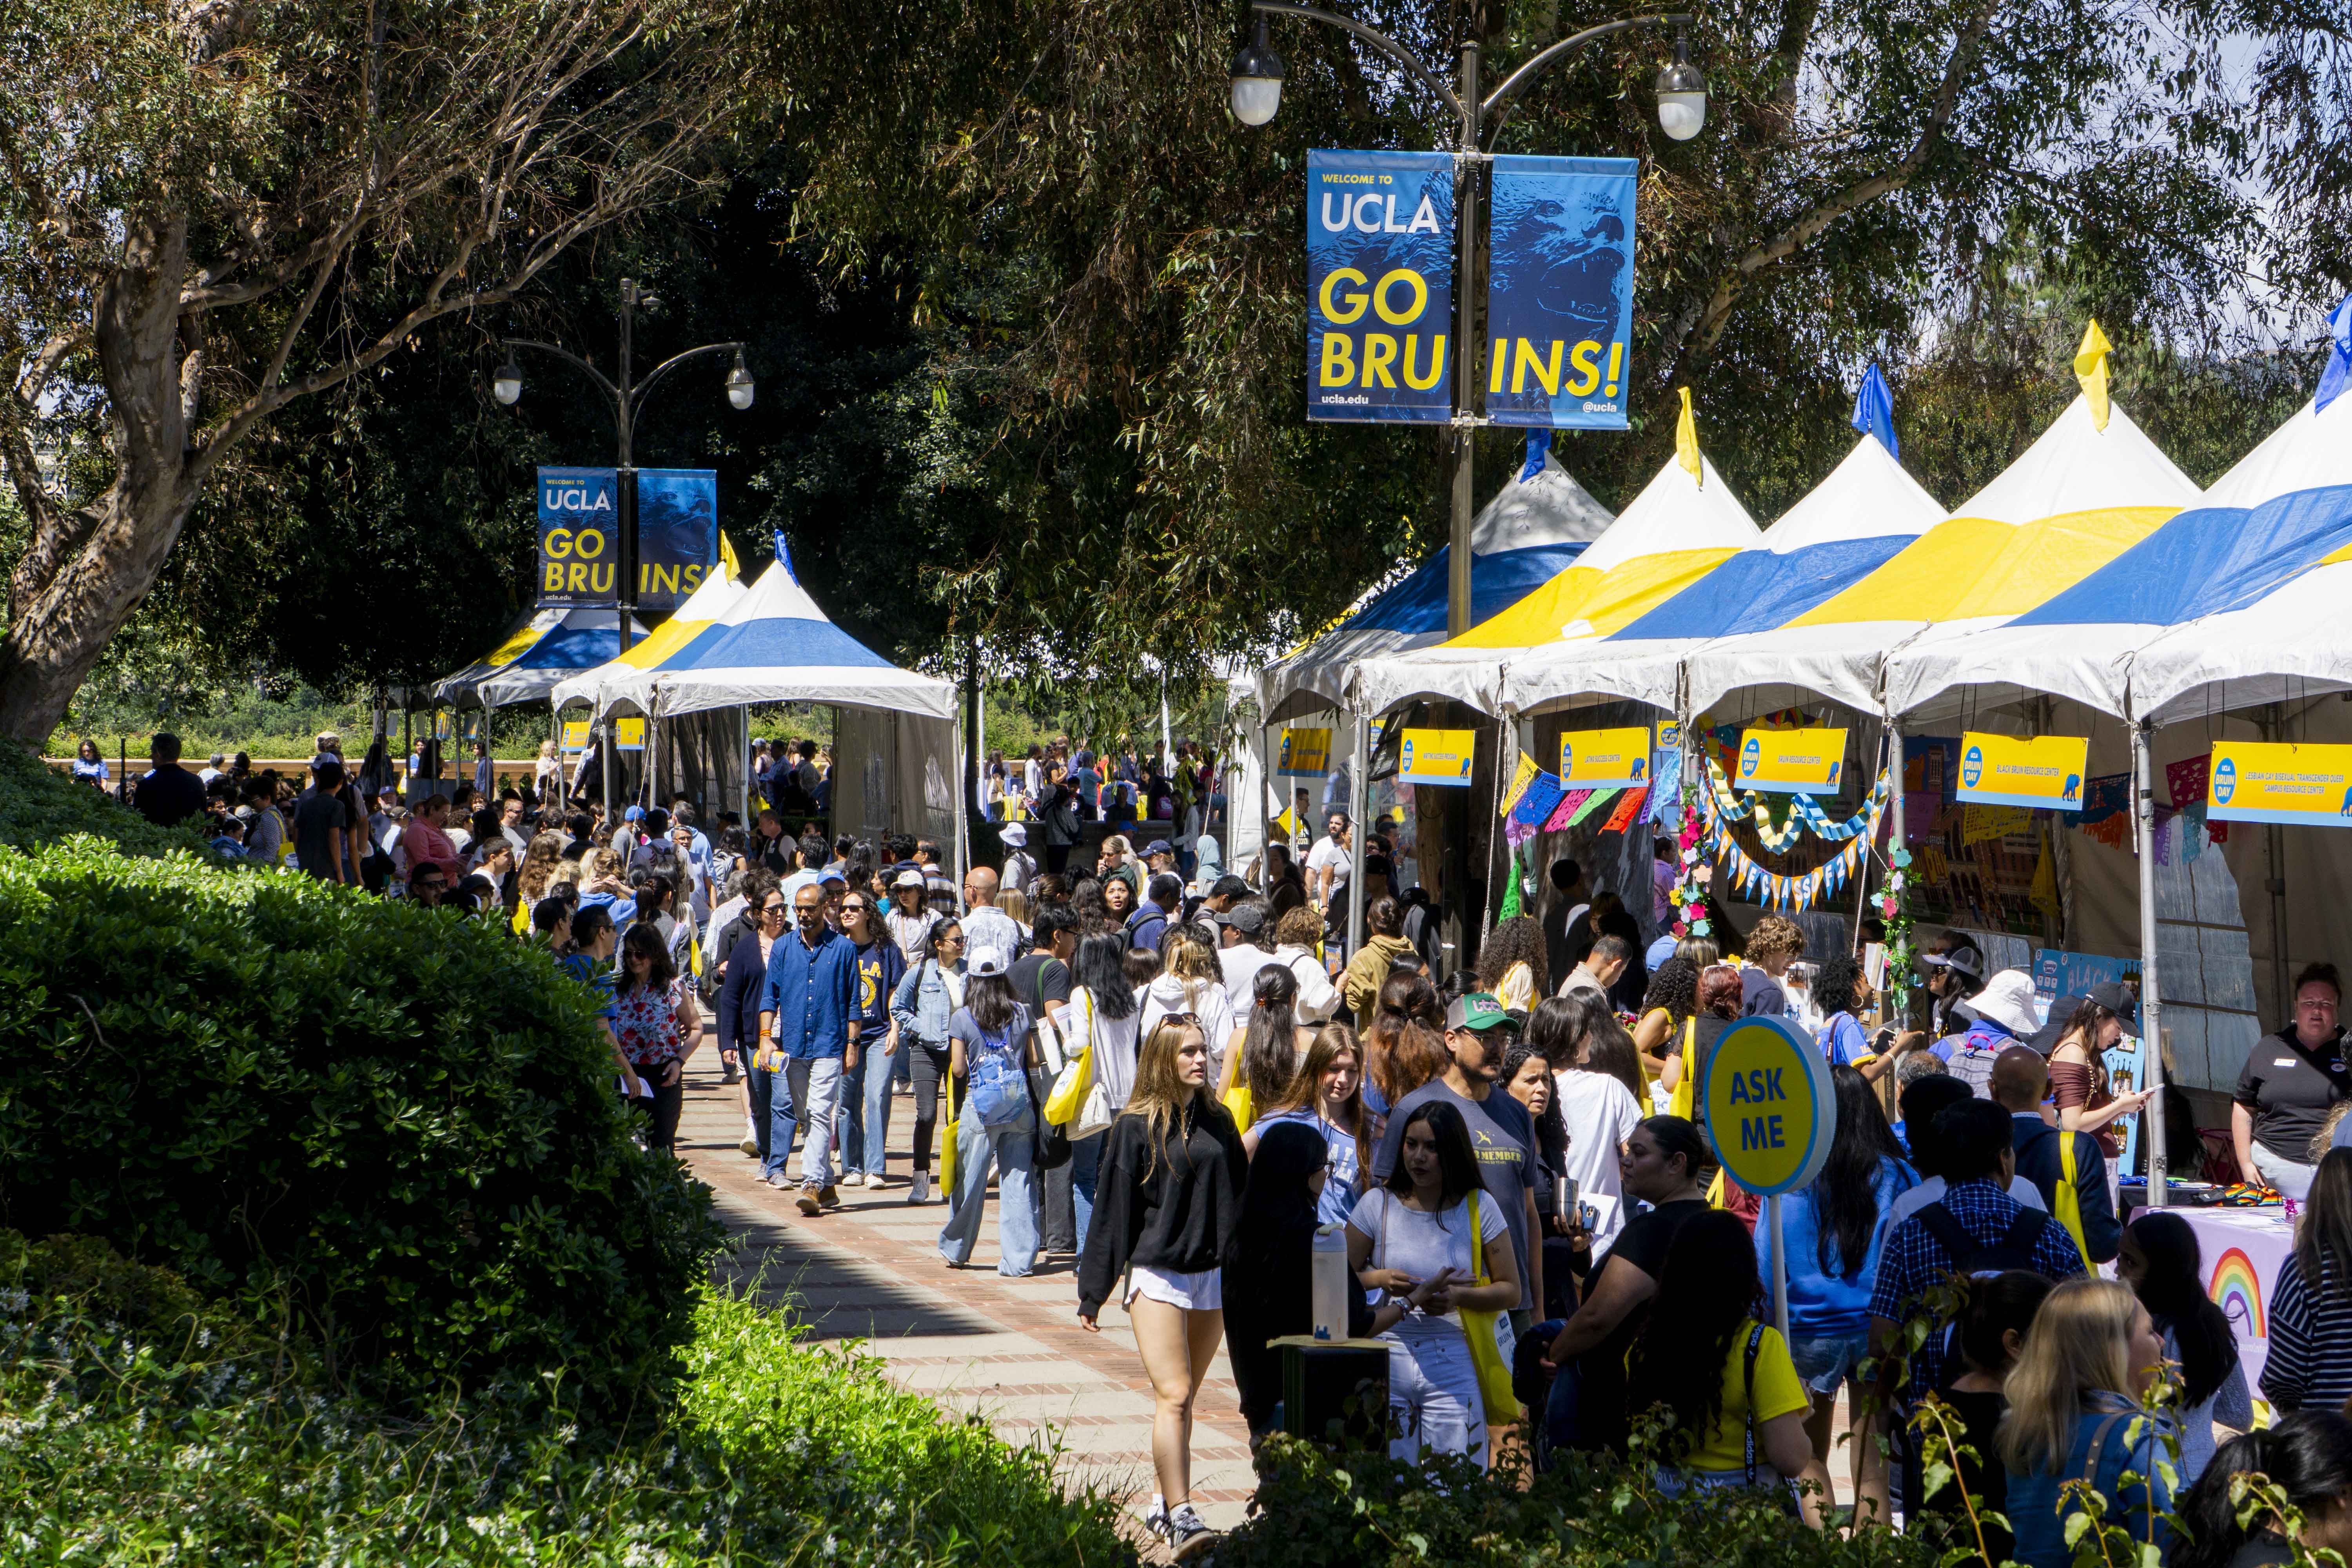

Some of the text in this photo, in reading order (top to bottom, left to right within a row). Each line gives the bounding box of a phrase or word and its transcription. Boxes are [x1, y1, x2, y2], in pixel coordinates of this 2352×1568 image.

[1322, 174, 1392, 184] WELCOME TO
[1321, 192, 1440, 233] UCLA
[1319, 267, 1428, 325] GO
[1319, 332, 1623, 398] BRU INS!
[1321, 395, 1369, 405] ucla.edu
[1583, 402, 1617, 413] @ucla
[546, 489, 611, 510] UCLA
[545, 528, 604, 559] GO
[544, 563, 615, 593] BRU
[1743, 752, 1758, 761] BRUIN
[1744, 762, 1755, 770] DAY
[1965, 760, 1981, 771] BRUIN
[1996, 765, 2059, 776] BLACK BRUIN RESOURCE CENTER
[1966, 772, 1977, 781] DAY
[2216, 774, 2234, 785] BRUIN
[2245, 772, 2264, 780] LESBIAN
[2297, 774, 2329, 782] TRANSGENDER
[2330, 775, 2344, 783] QUEER
[2218, 787, 2231, 797] DAY
[2264, 784, 2282, 793] CAMPUS
[1762, 875, 1811, 901] CLASS
[1812, 864, 1833, 893] OF
[858, 960, 882, 978] LA
[1730, 1067, 1786, 1105] ASK
[1741, 1115, 1785, 1151] ME
[1481, 1151, 1521, 1162] MEMBER
[1497, 1330, 1512, 1347] BRUIN
[1746, 1430, 1754, 1464] adidas
